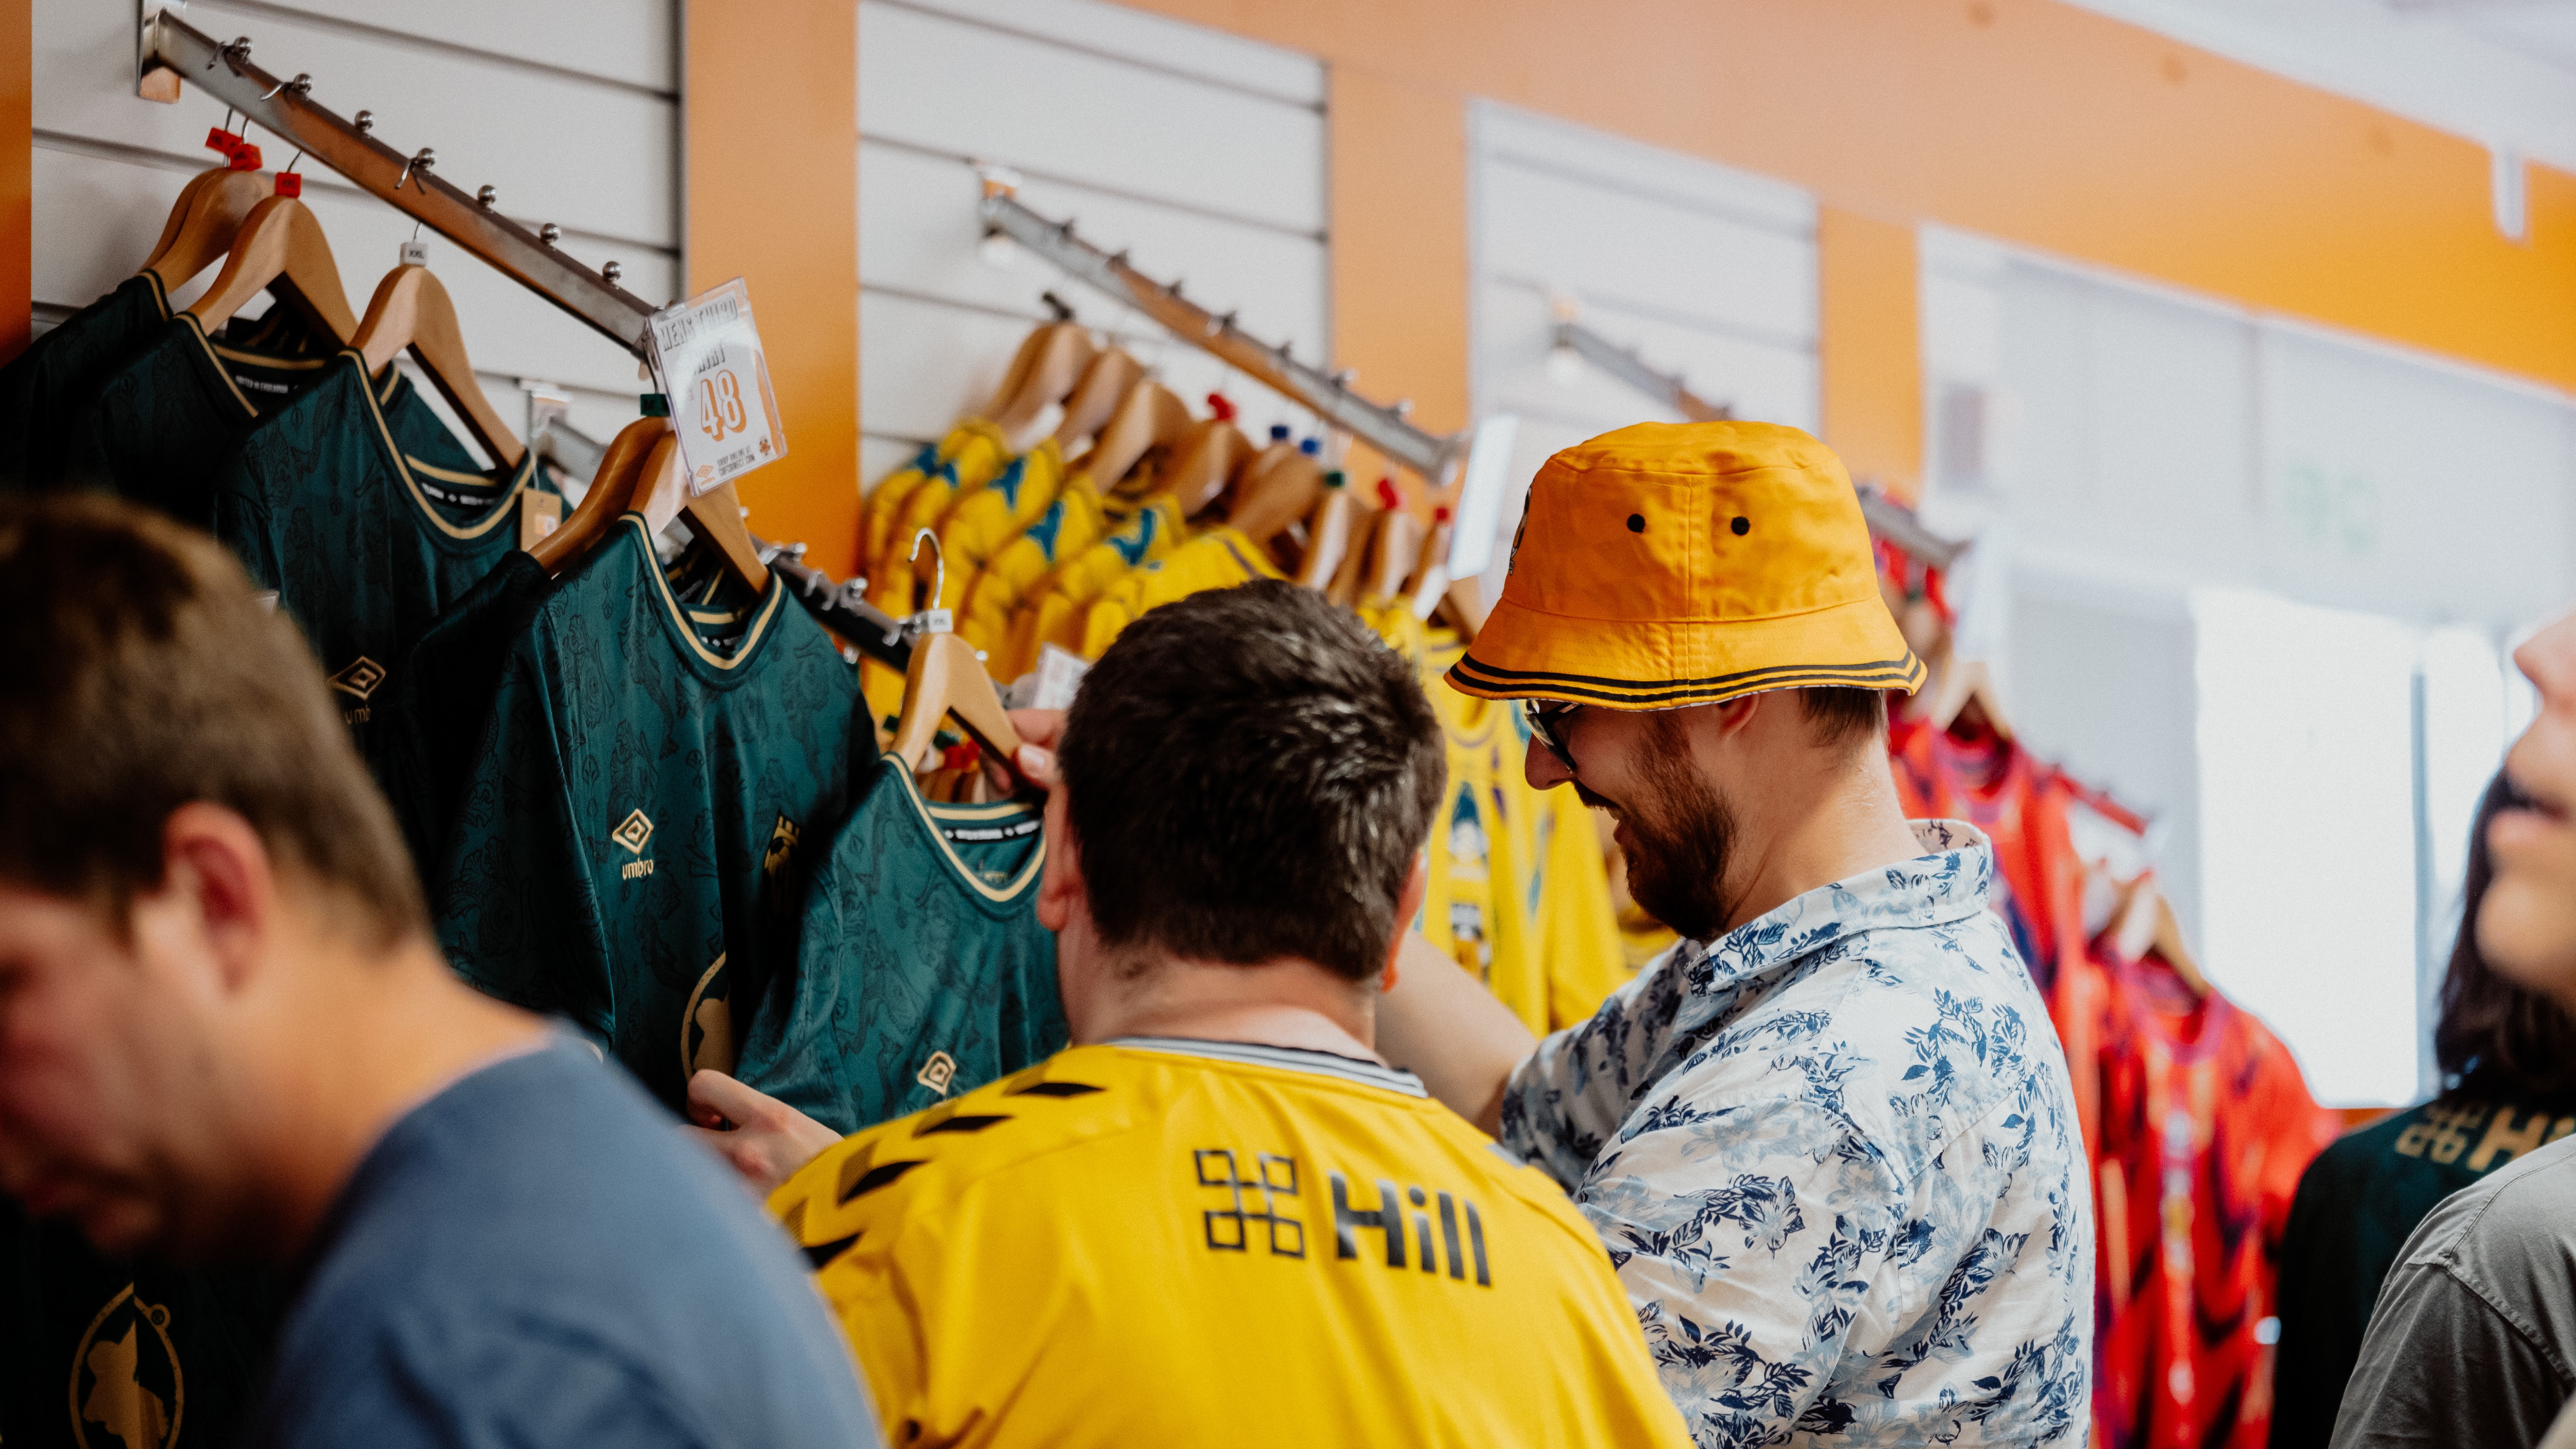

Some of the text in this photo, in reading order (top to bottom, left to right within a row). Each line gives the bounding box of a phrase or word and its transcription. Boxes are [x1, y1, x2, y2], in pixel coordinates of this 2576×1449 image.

[701, 369, 747, 442] 48
[345, 704, 371, 725] umb
[622, 857, 654, 880] umbro
[1327, 1170, 1492, 1287] Hill
